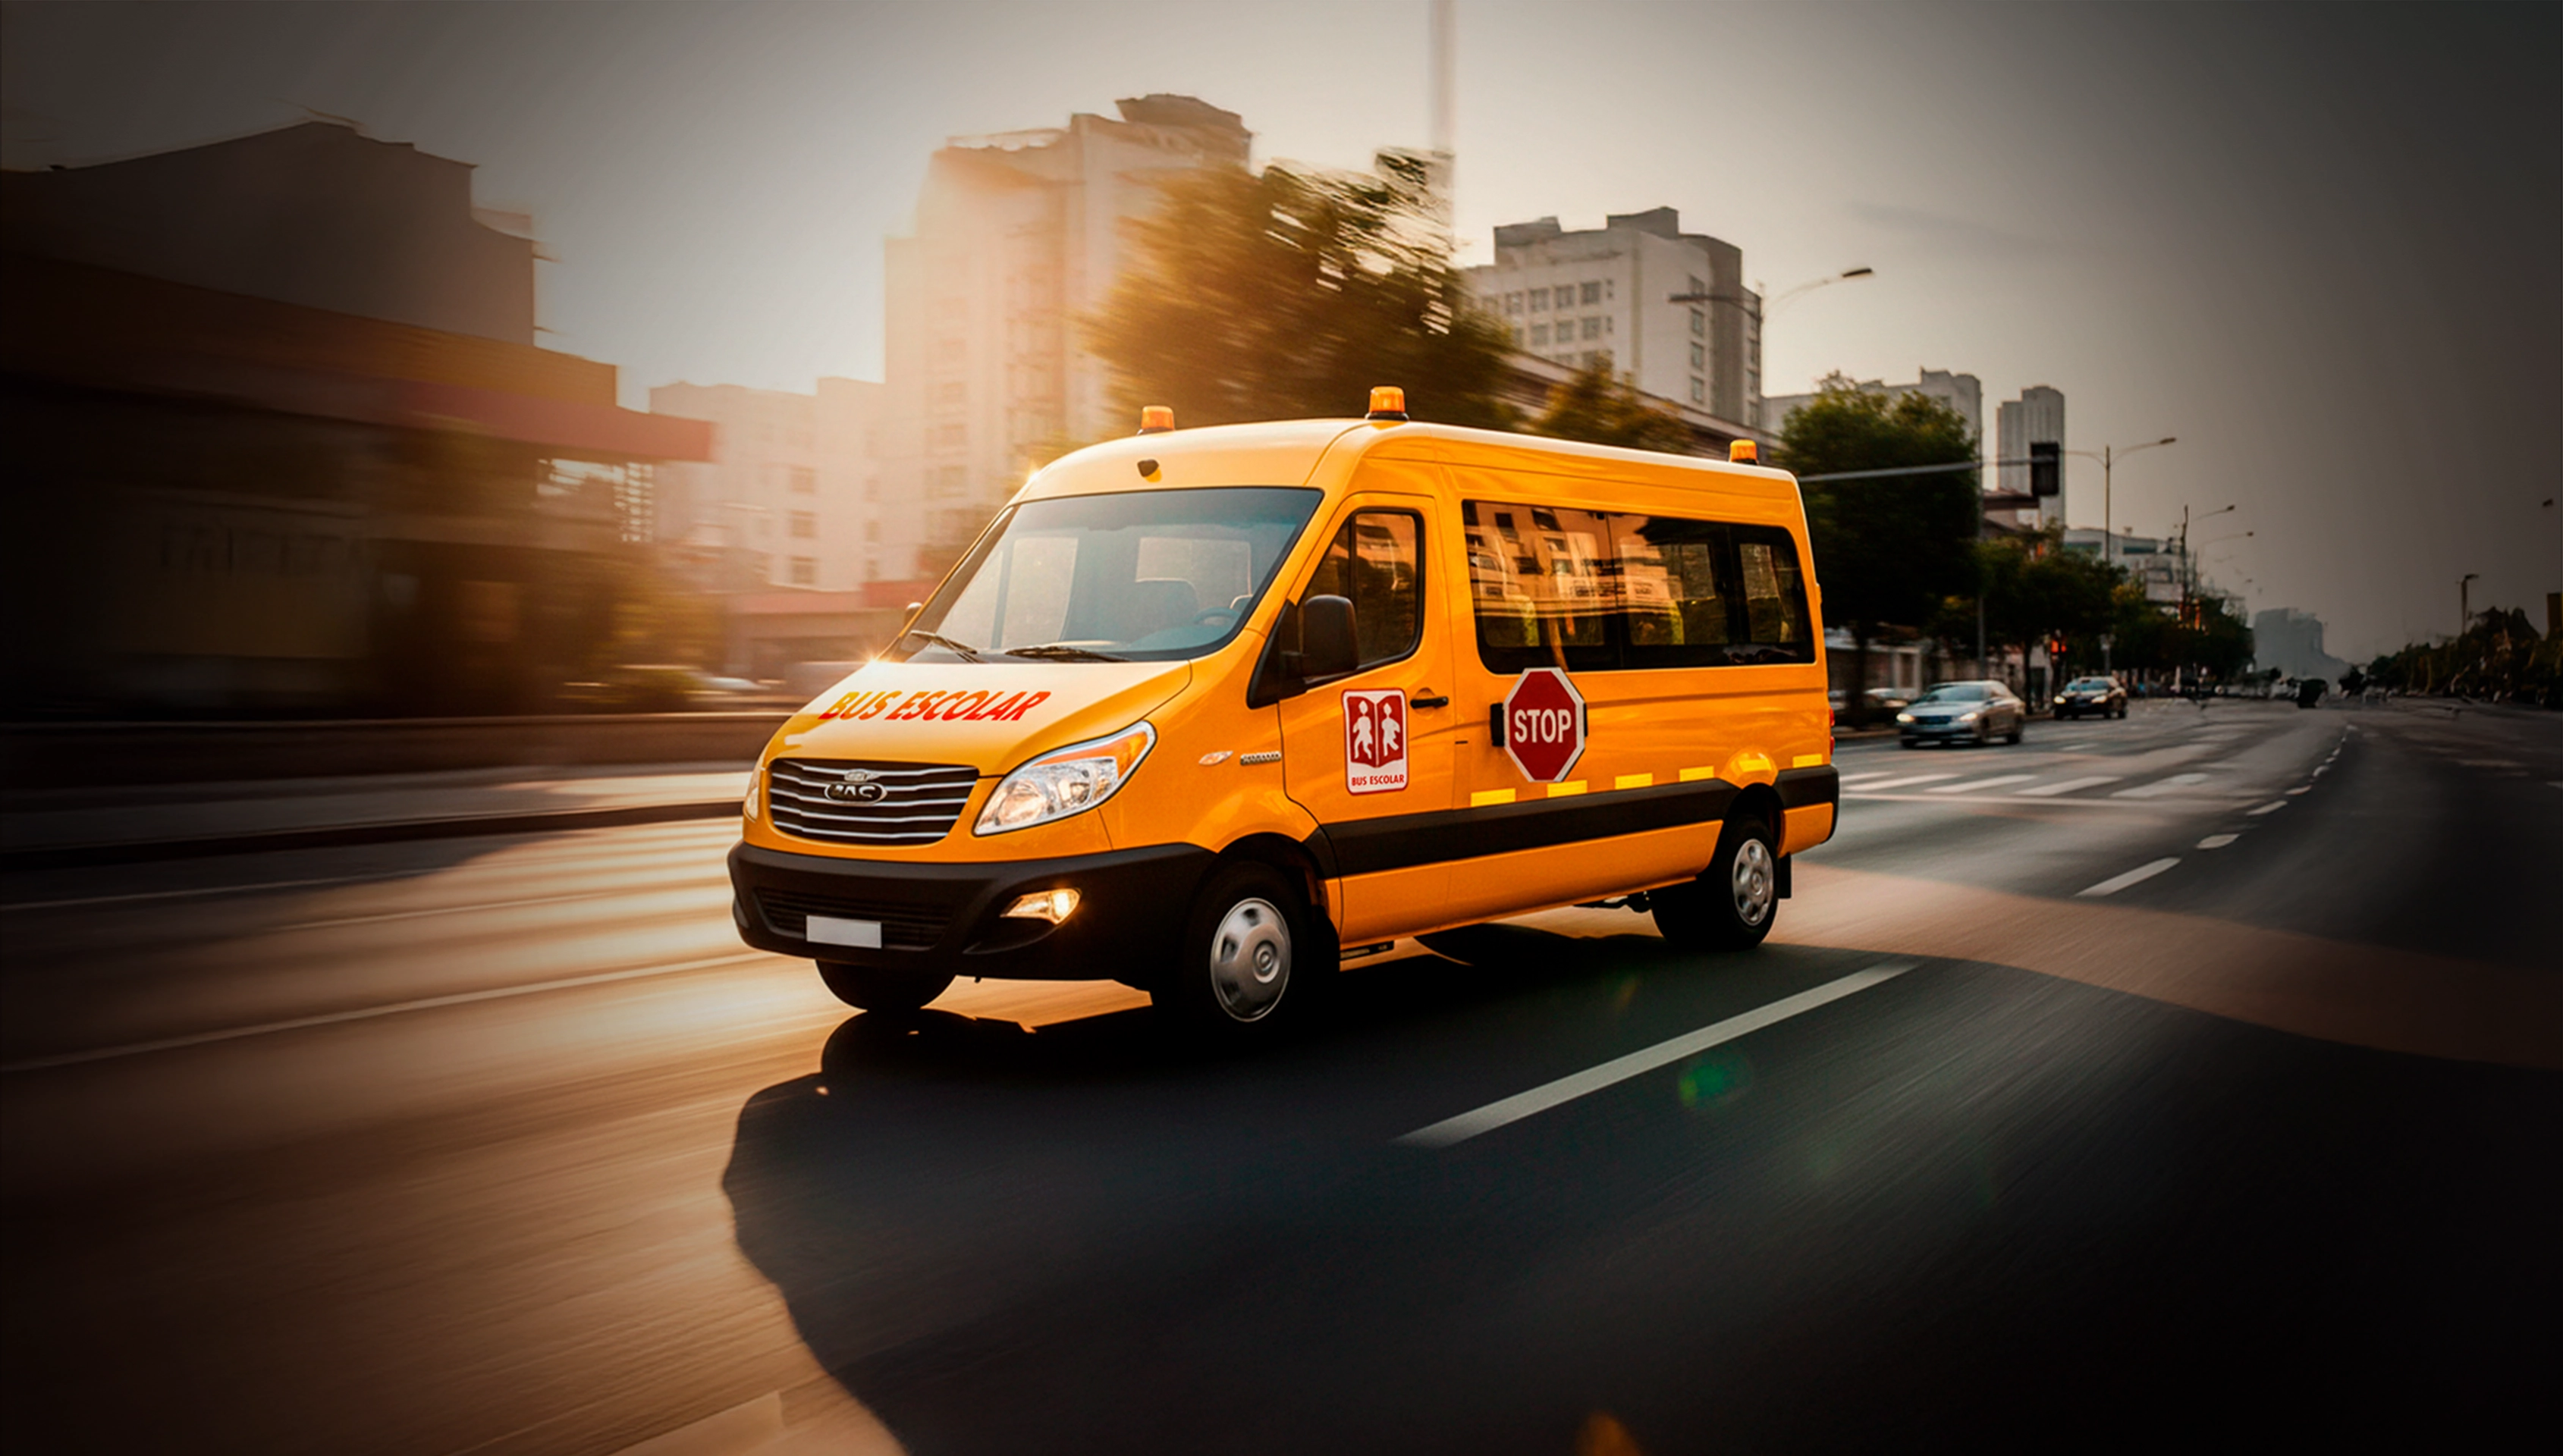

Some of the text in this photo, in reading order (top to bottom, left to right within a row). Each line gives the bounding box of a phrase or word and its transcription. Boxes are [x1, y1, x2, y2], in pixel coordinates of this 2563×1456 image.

[818, 690, 1051, 721] BUS ESCOLAR
[1515, 709, 1572, 743] STOP
[1352, 774, 1404, 786] BUS ESCOLAR
